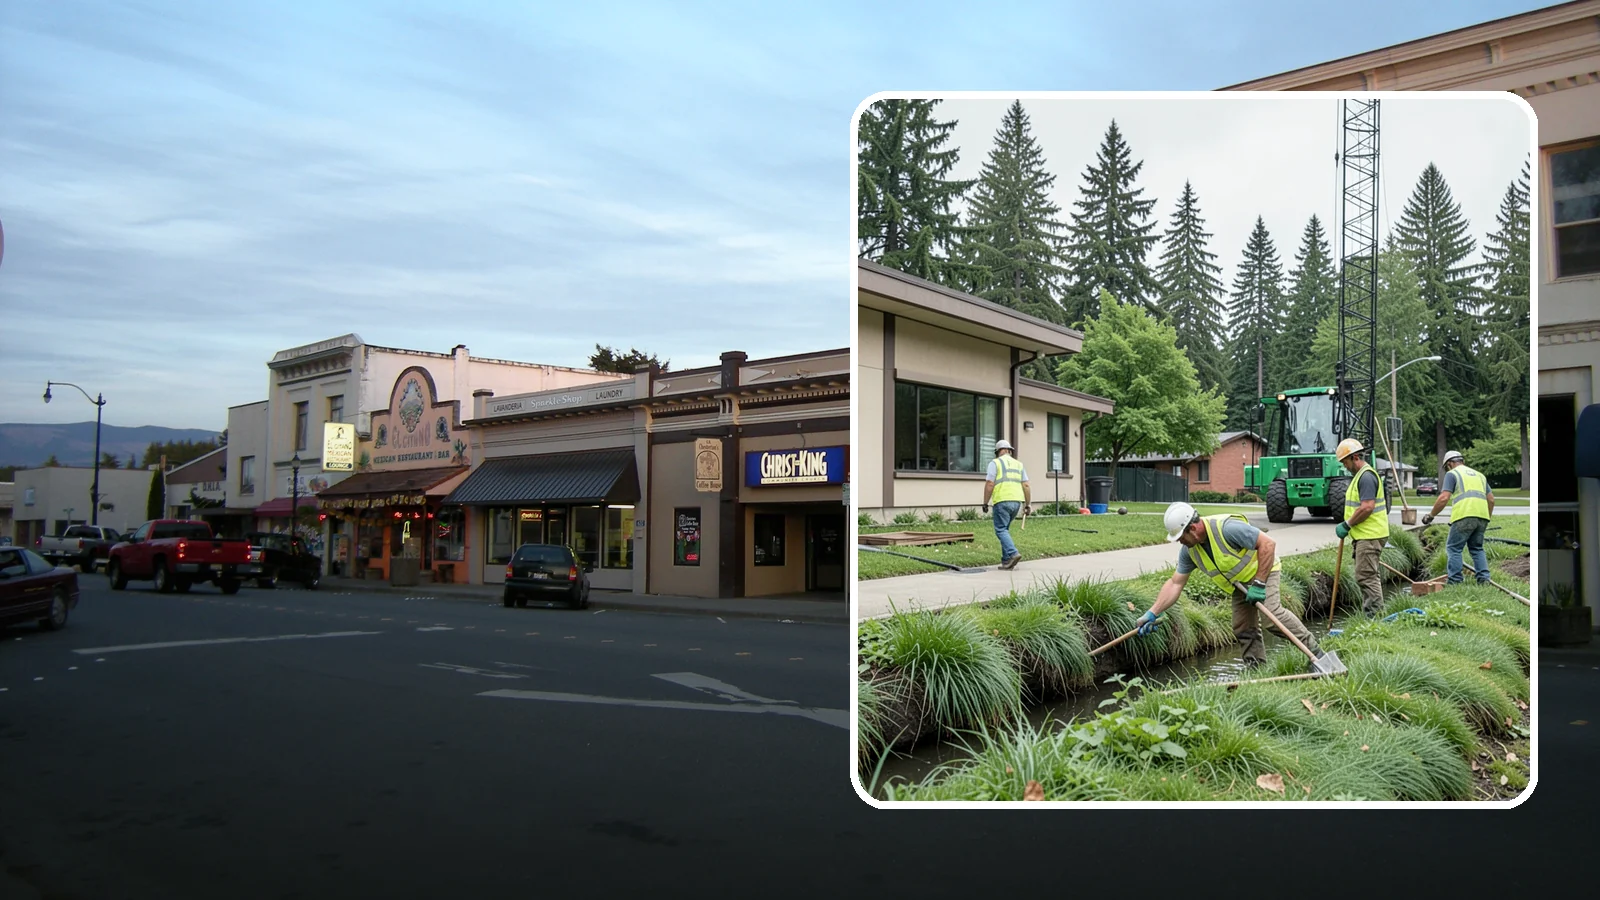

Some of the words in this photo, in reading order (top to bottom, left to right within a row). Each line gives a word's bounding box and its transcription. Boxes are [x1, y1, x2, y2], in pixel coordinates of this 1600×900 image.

[531, 397, 561, 409] Sparkle
[562, 394, 583, 405] Shop
[595, 388, 624, 400] LAUNDRY
[493, 402, 522, 413] LAVANDERIA
[392, 425, 402, 449] EL
[373, 455, 396, 465] MEXICAN
[397, 451, 433, 462] RESTAURANT
[438, 450, 450, 459] BAR
[760, 451, 797, 478] CHRIST
[799, 450, 828, 476] KING
[696, 480, 709, 489] Coffee
[709, 480, 722, 489] House
